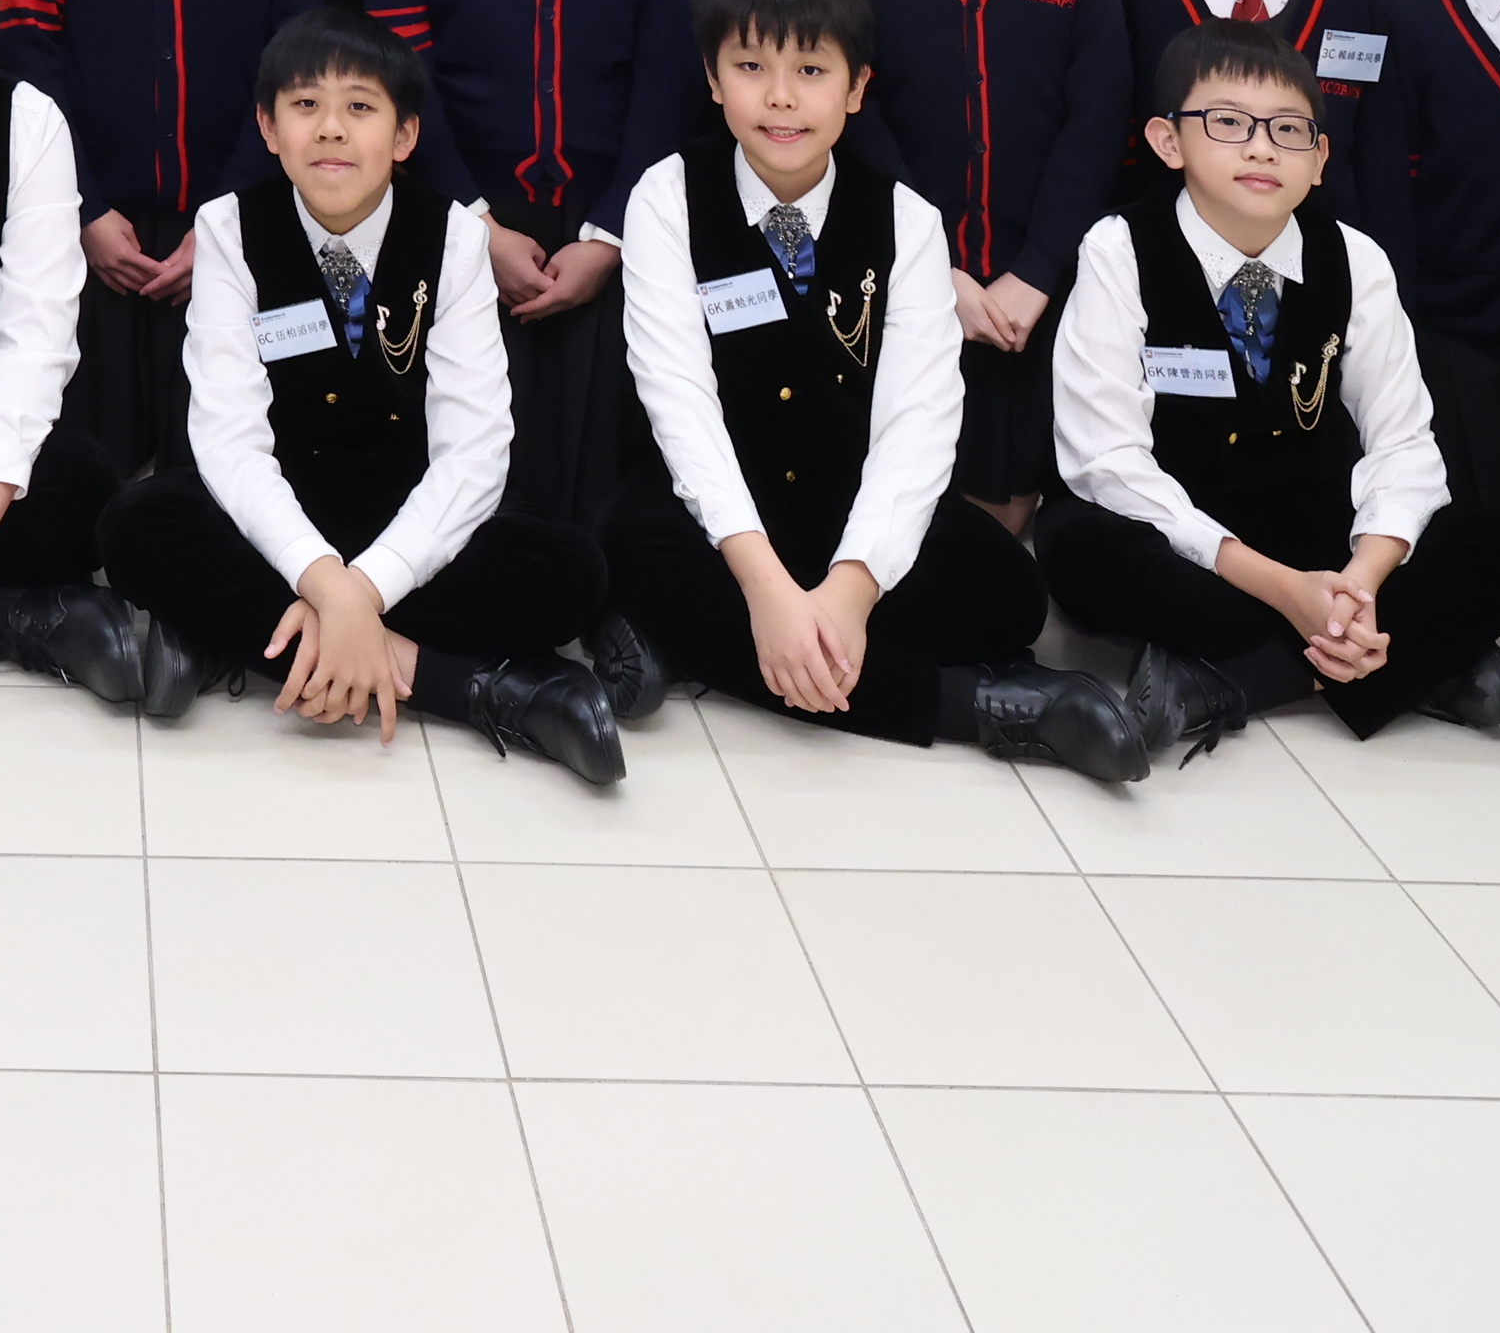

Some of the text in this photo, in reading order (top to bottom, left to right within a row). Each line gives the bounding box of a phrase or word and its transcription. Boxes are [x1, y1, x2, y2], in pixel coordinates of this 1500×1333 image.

[1322, 48, 1335, 59] 3C
[707, 302, 724, 315] 6K
[258, 333, 274, 346] 6C
[1147, 366, 1166, 378] 6K
